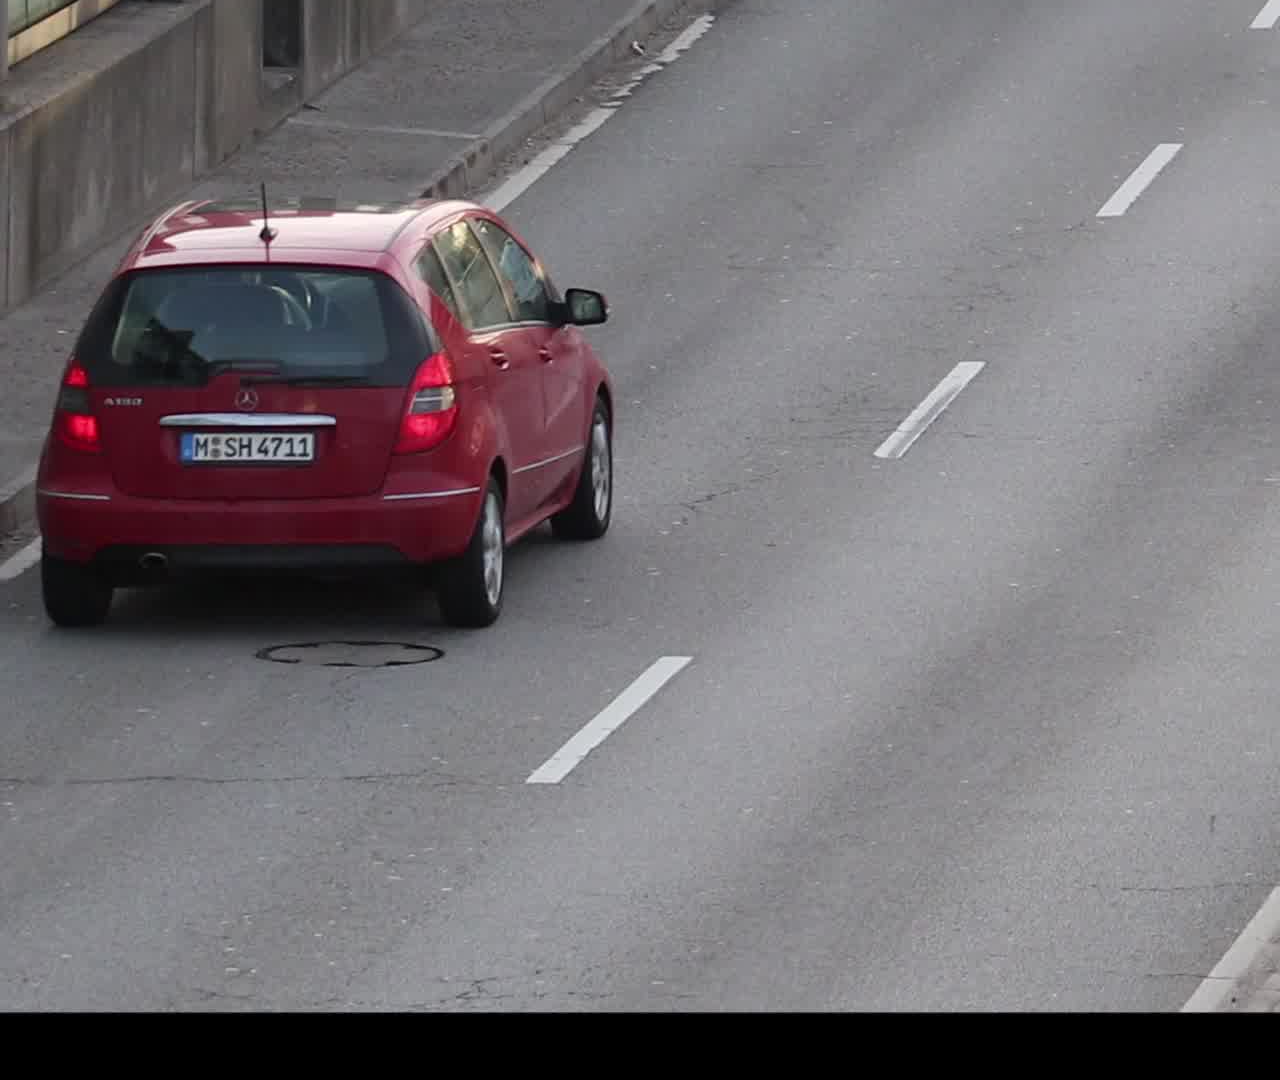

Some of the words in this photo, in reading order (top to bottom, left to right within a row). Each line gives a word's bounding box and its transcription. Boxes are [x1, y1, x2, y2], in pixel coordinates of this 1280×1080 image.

[195, 438, 208, 457] M
[224, 438, 252, 457] SH
[258, 438, 310, 457] 4711
